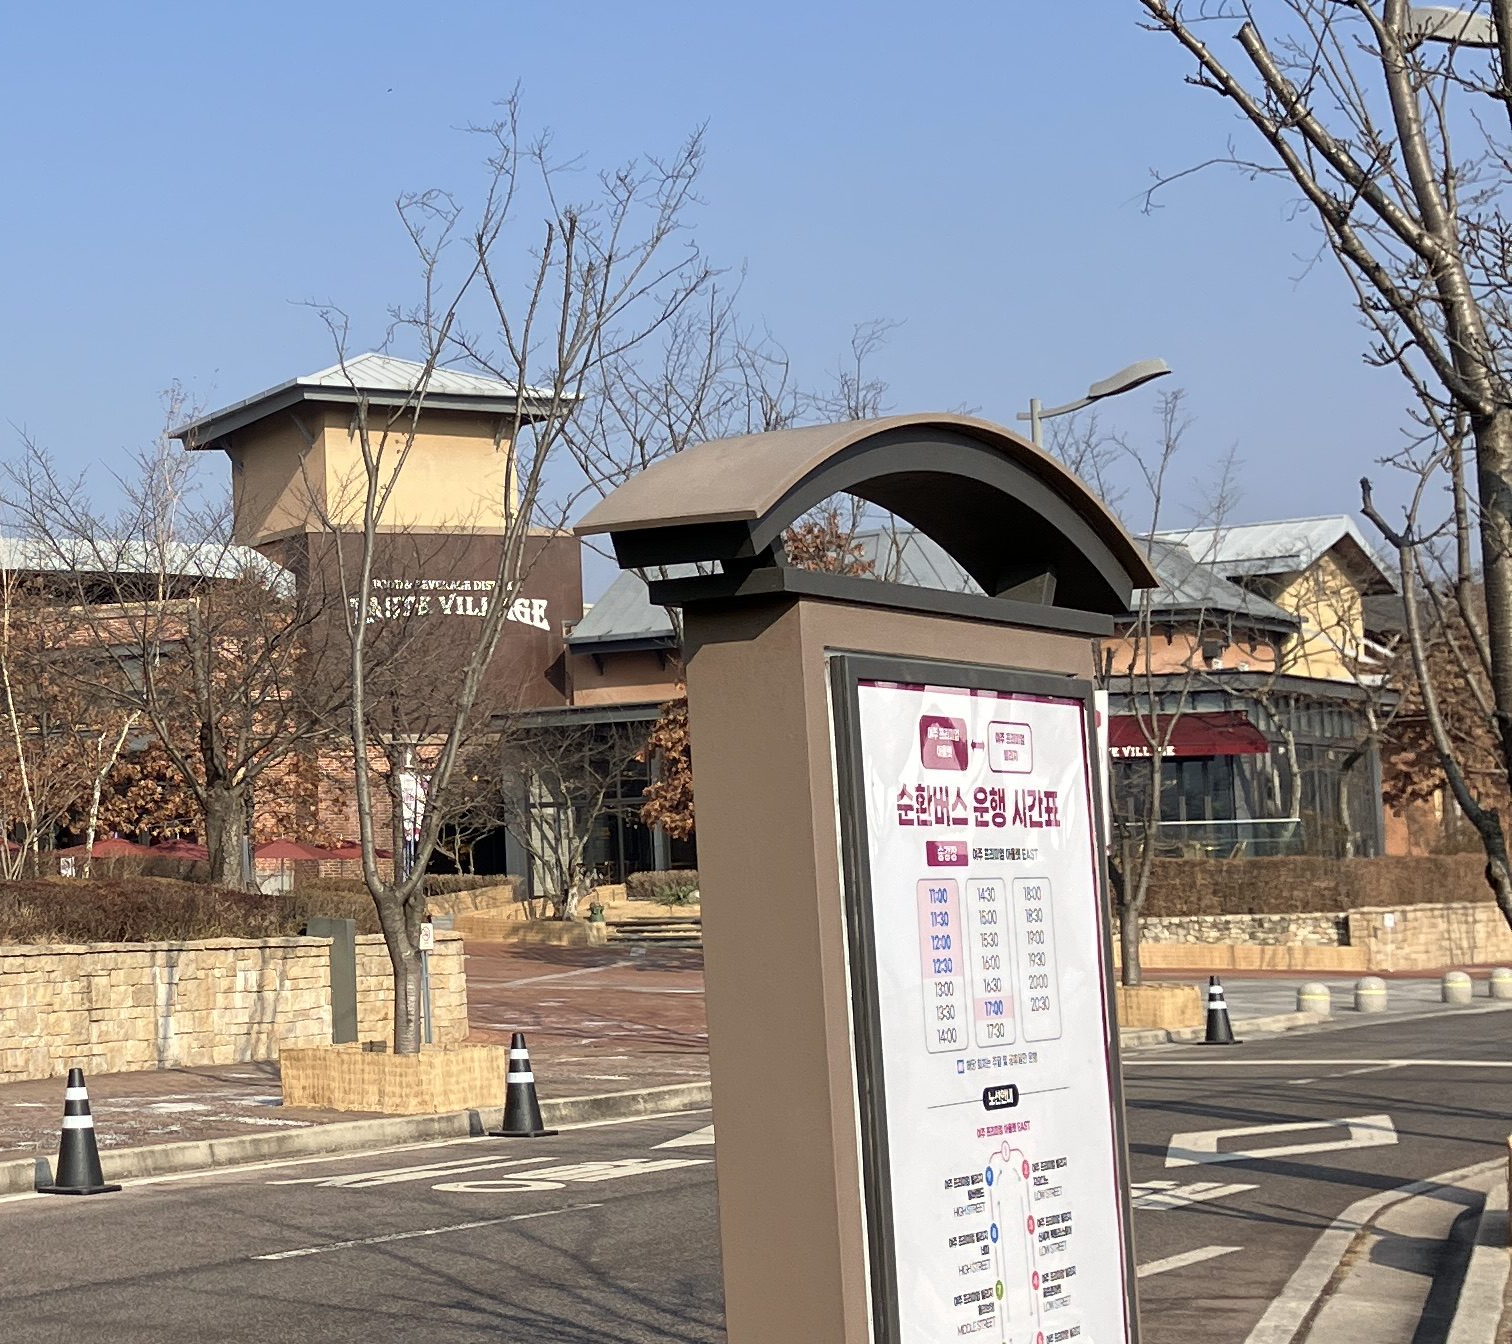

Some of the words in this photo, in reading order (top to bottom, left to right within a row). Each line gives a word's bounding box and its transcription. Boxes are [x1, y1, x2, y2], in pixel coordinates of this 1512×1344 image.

[1121, 746, 1176, 757] VILLE
[897, 784, 968, 826] 순환버스
[974, 787, 1006, 828] 운행
[1013, 789, 1061, 828] 시간표
[938, 846, 958, 862] 승강장
[1022, 848, 1038, 860] EAST
[929, 888, 947, 903] 11:00
[977, 887, 995, 902] 14:30
[1023, 886, 1041, 901] 18:00
[931, 911, 949, 927] 11:30
[979, 910, 997, 925] 15:00
[1025, 908, 1043, 923] 18:30
[931, 935, 951, 950] 12:00
[980, 932, 998, 948] 15:30
[1026, 930, 1044, 945] 19:00
[933, 958, 952, 973] 12:30
[982, 955, 1000, 970] 16:00
[1028, 952, 1046, 967] 19:30
[935, 981, 953, 997] 13:00
[984, 977, 1002, 993] 16:30
[1029, 974, 1048, 989] 20:00
[985, 1000, 1003, 1016] 17:00
[1031, 996, 1050, 1012] 20:30
[936, 1005, 955, 1021] 13:30
[937, 1028, 957, 1044] 14:00
[987, 1023, 1004, 1038] 17:30
